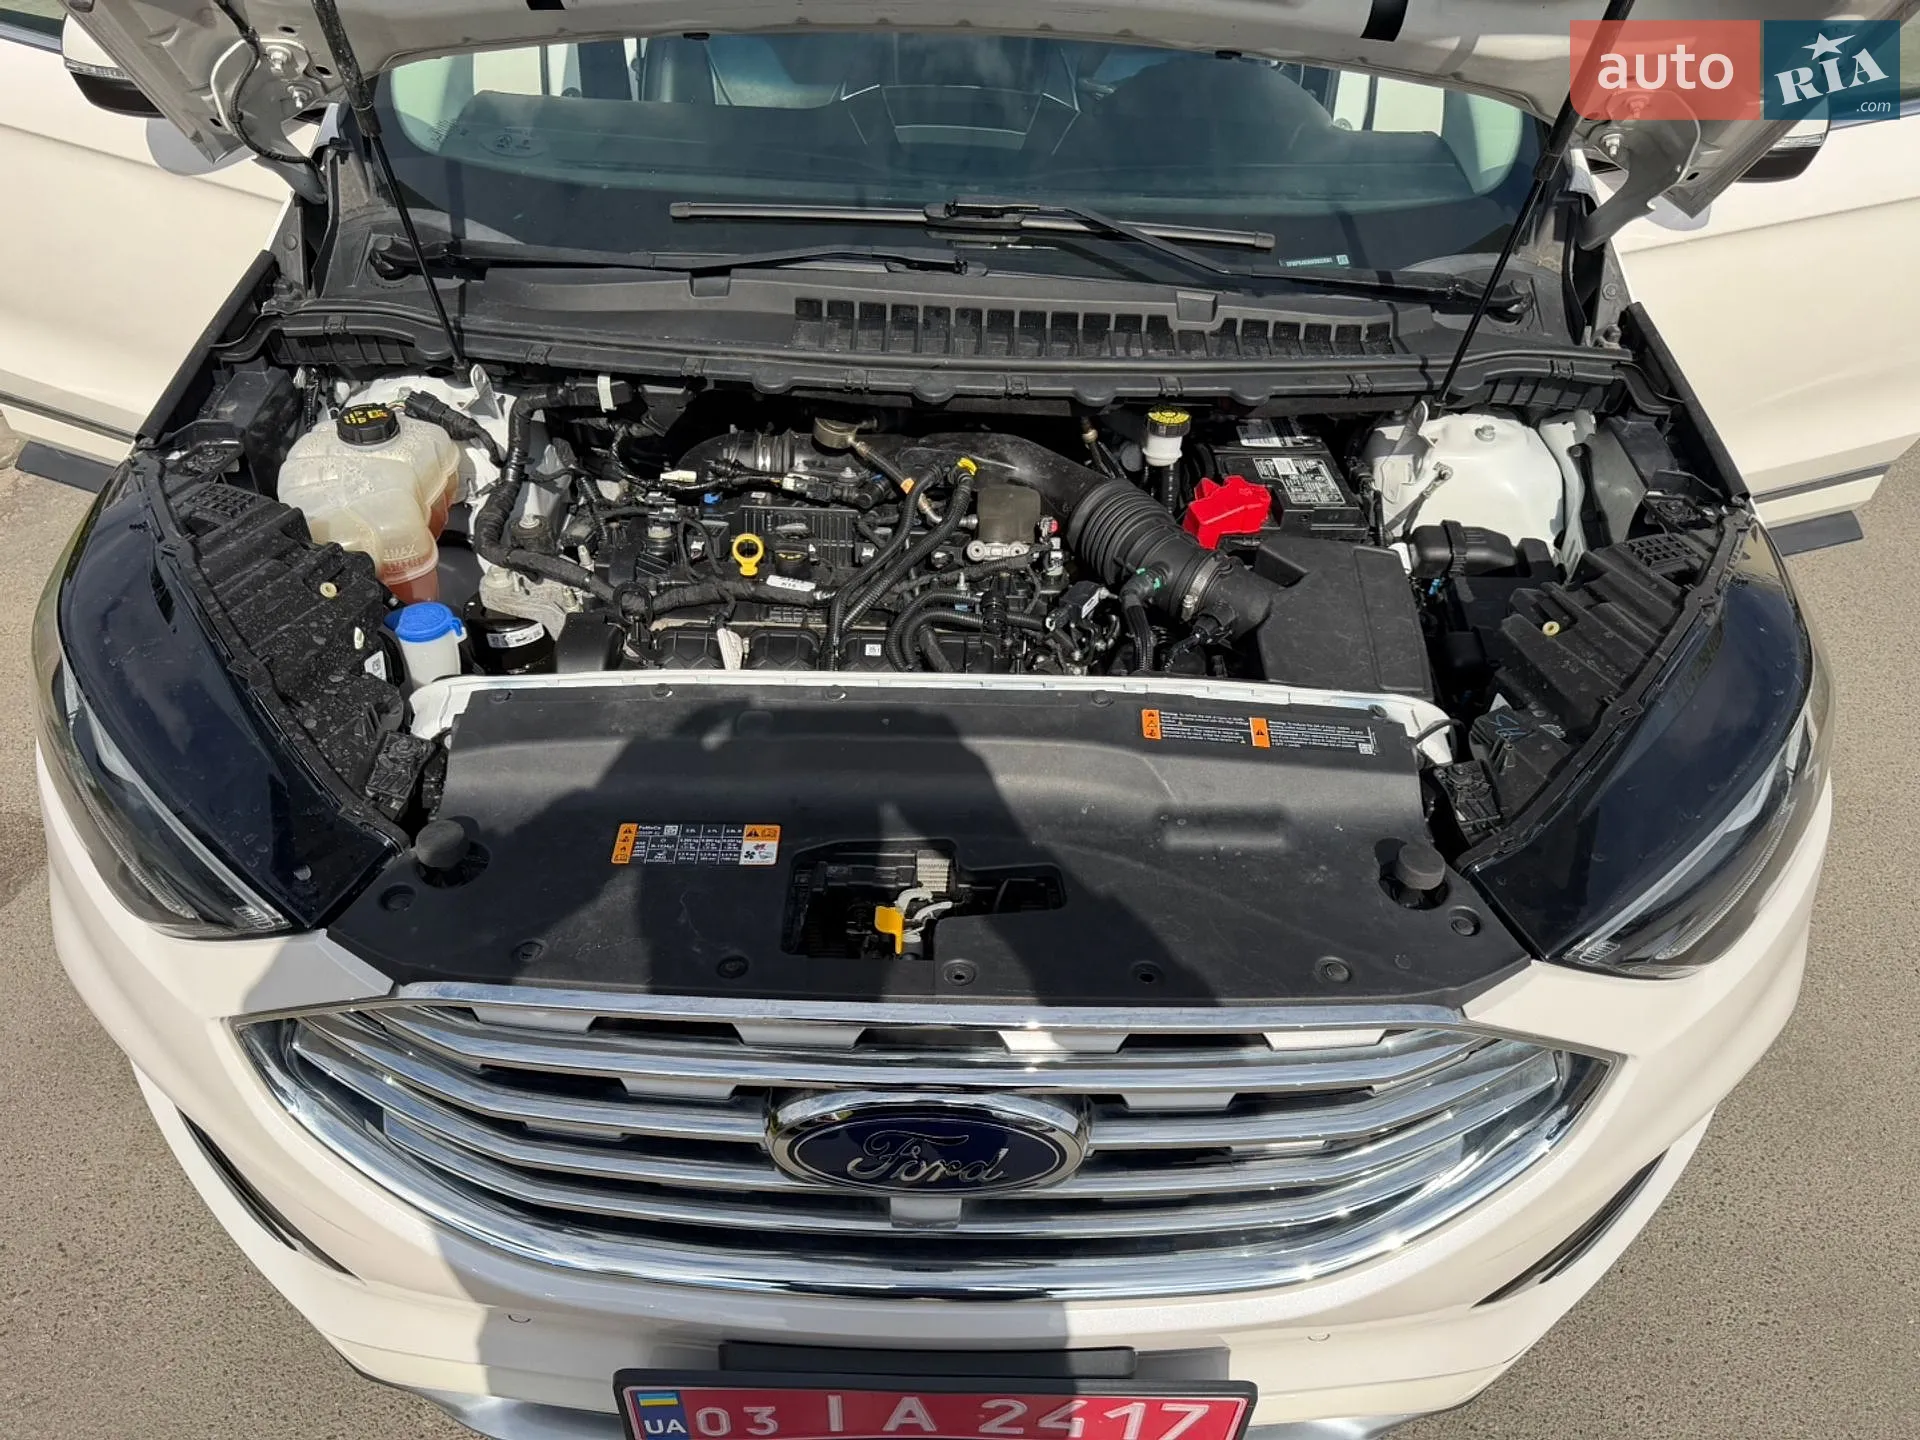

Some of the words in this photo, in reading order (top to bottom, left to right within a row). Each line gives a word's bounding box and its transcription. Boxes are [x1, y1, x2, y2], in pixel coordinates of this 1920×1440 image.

[847, 1129, 1009, 1183] Ford
[643, 1418, 688, 1435] UA
[695, 1406, 779, 1437] 03
[978, 1398, 1210, 1440] 2417
